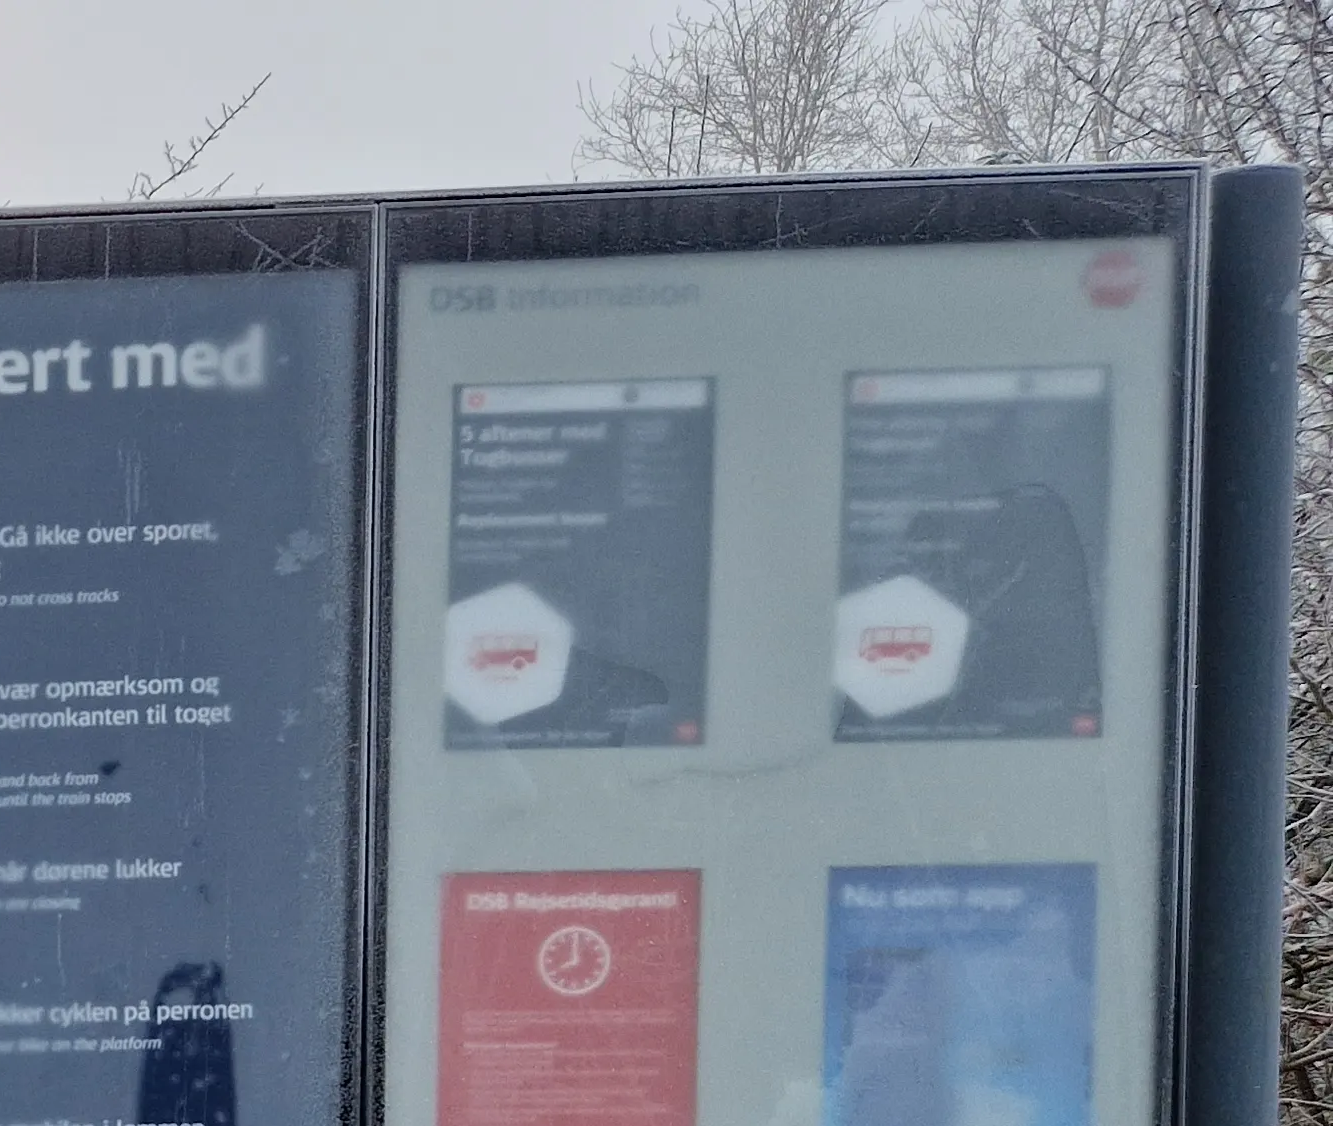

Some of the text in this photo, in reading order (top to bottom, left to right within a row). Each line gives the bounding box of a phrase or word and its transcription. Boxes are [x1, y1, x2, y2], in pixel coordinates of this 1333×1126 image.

[111, 324, 267, 390] med
[35, 524, 79, 546] ikke
[86, 525, 136, 544] over
[38, 591, 72, 605] cross
[77, 589, 119, 604] tracks
[45, 675, 183, 702] opmærksom
[190, 676, 220, 699] og
[146, 704, 167, 724] til
[174, 704, 231, 727] toget
[28, 772, 59, 786] back
[64, 771, 98, 786] from
[57, 791, 90, 805] train
[94, 791, 131, 806] stops
[115, 858, 183, 878] lukker
[50, 1000, 253, 1028] cyklen på perronen
[100, 1036, 162, 1053] platform
